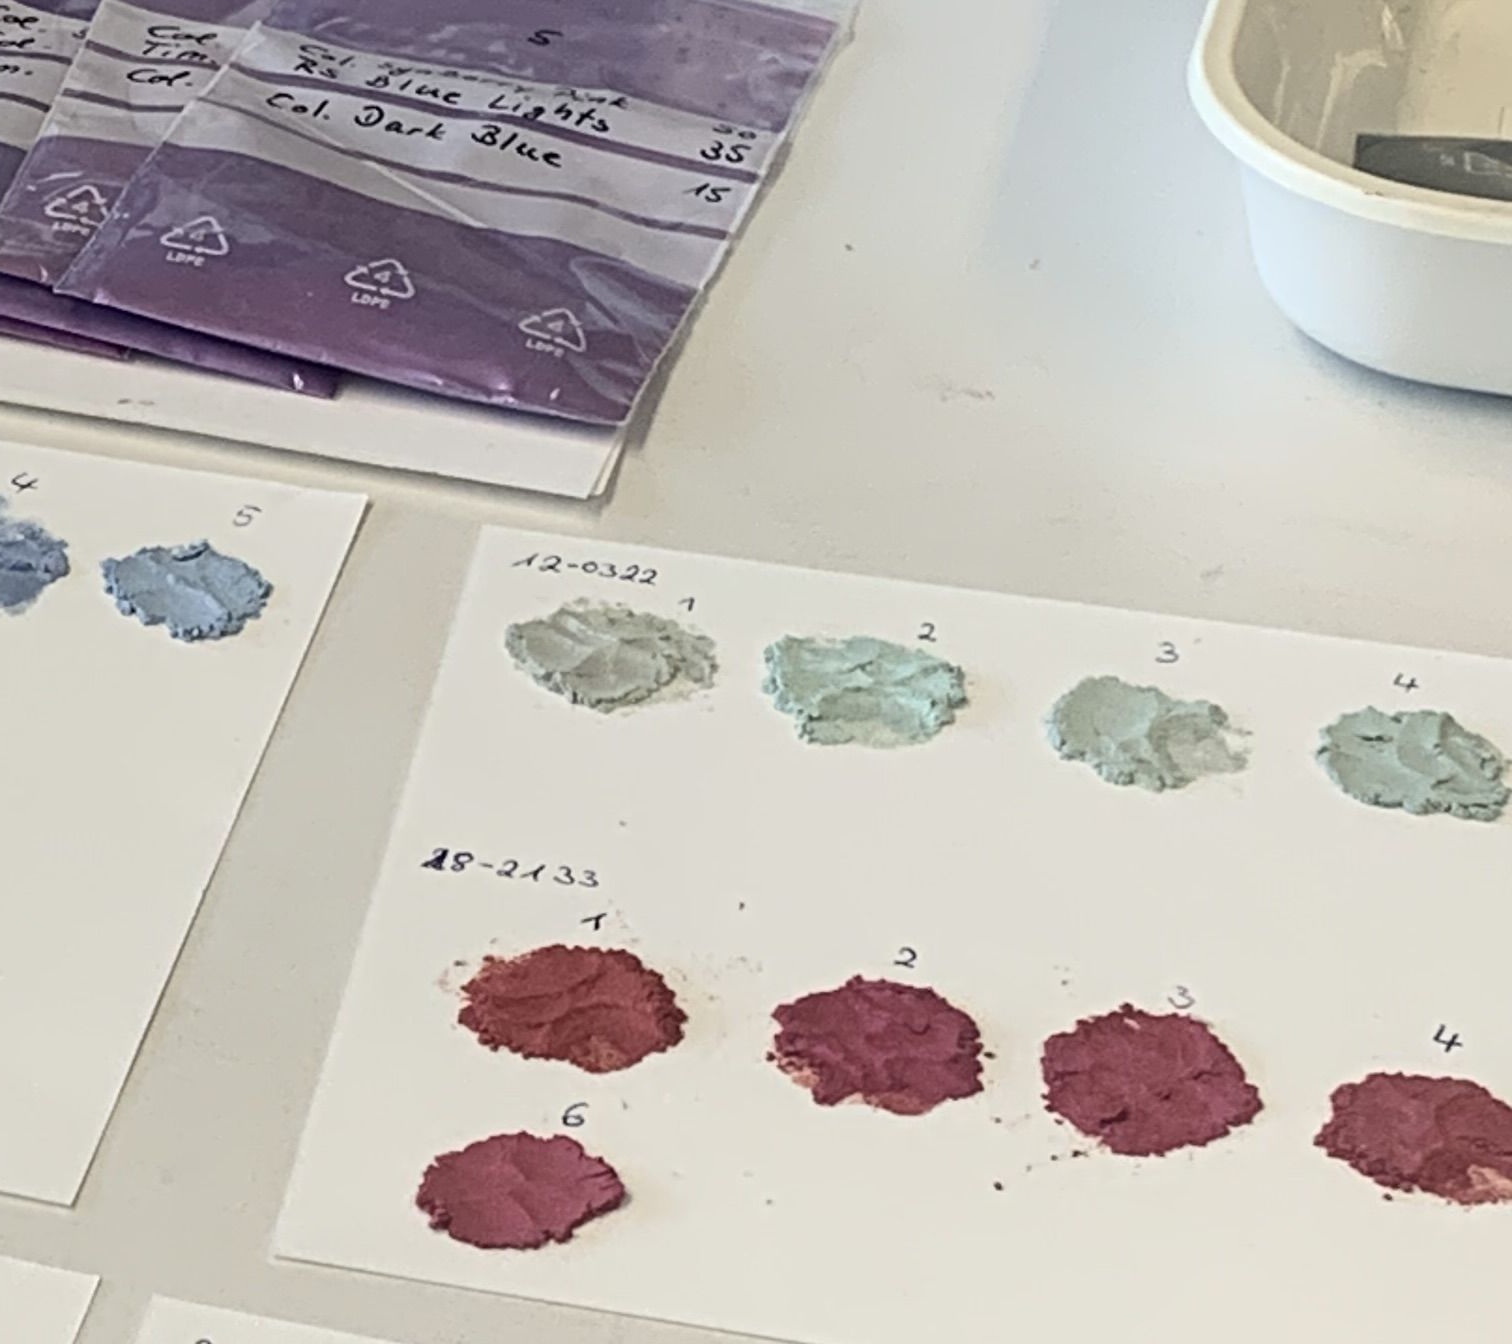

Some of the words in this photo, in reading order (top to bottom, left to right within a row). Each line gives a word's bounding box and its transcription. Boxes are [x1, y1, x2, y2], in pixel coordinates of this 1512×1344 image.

[527, 28, 563, 47] 5
[366, 72, 462, 106] Blue
[488, 93, 611, 134] Lights
[700, 140, 751, 163] 35
[265, 92, 331, 120] Col.
[354, 104, 447, 142] Dark
[471, 123, 563, 168] Blue
[683, 182, 732, 204] 15
[165, 250, 206, 267] LDPE
[351, 291, 390, 310] LDPE
[525, 337, 565, 357] LDPE
[10, 472, 38, 494] 4
[232, 505, 262, 527] 5
[511, 553, 659, 586] 12-0322
[677, 596, 695, 612] 1
[917, 621, 937, 643] 2
[1154, 640, 1180, 664] 3
[1392, 672, 1420, 694] 4
[893, 946, 919, 969] 2
[1167, 985, 1196, 1009] 3
[1432, 1023, 1464, 1053] 4
[561, 1101, 591, 1128] 6
